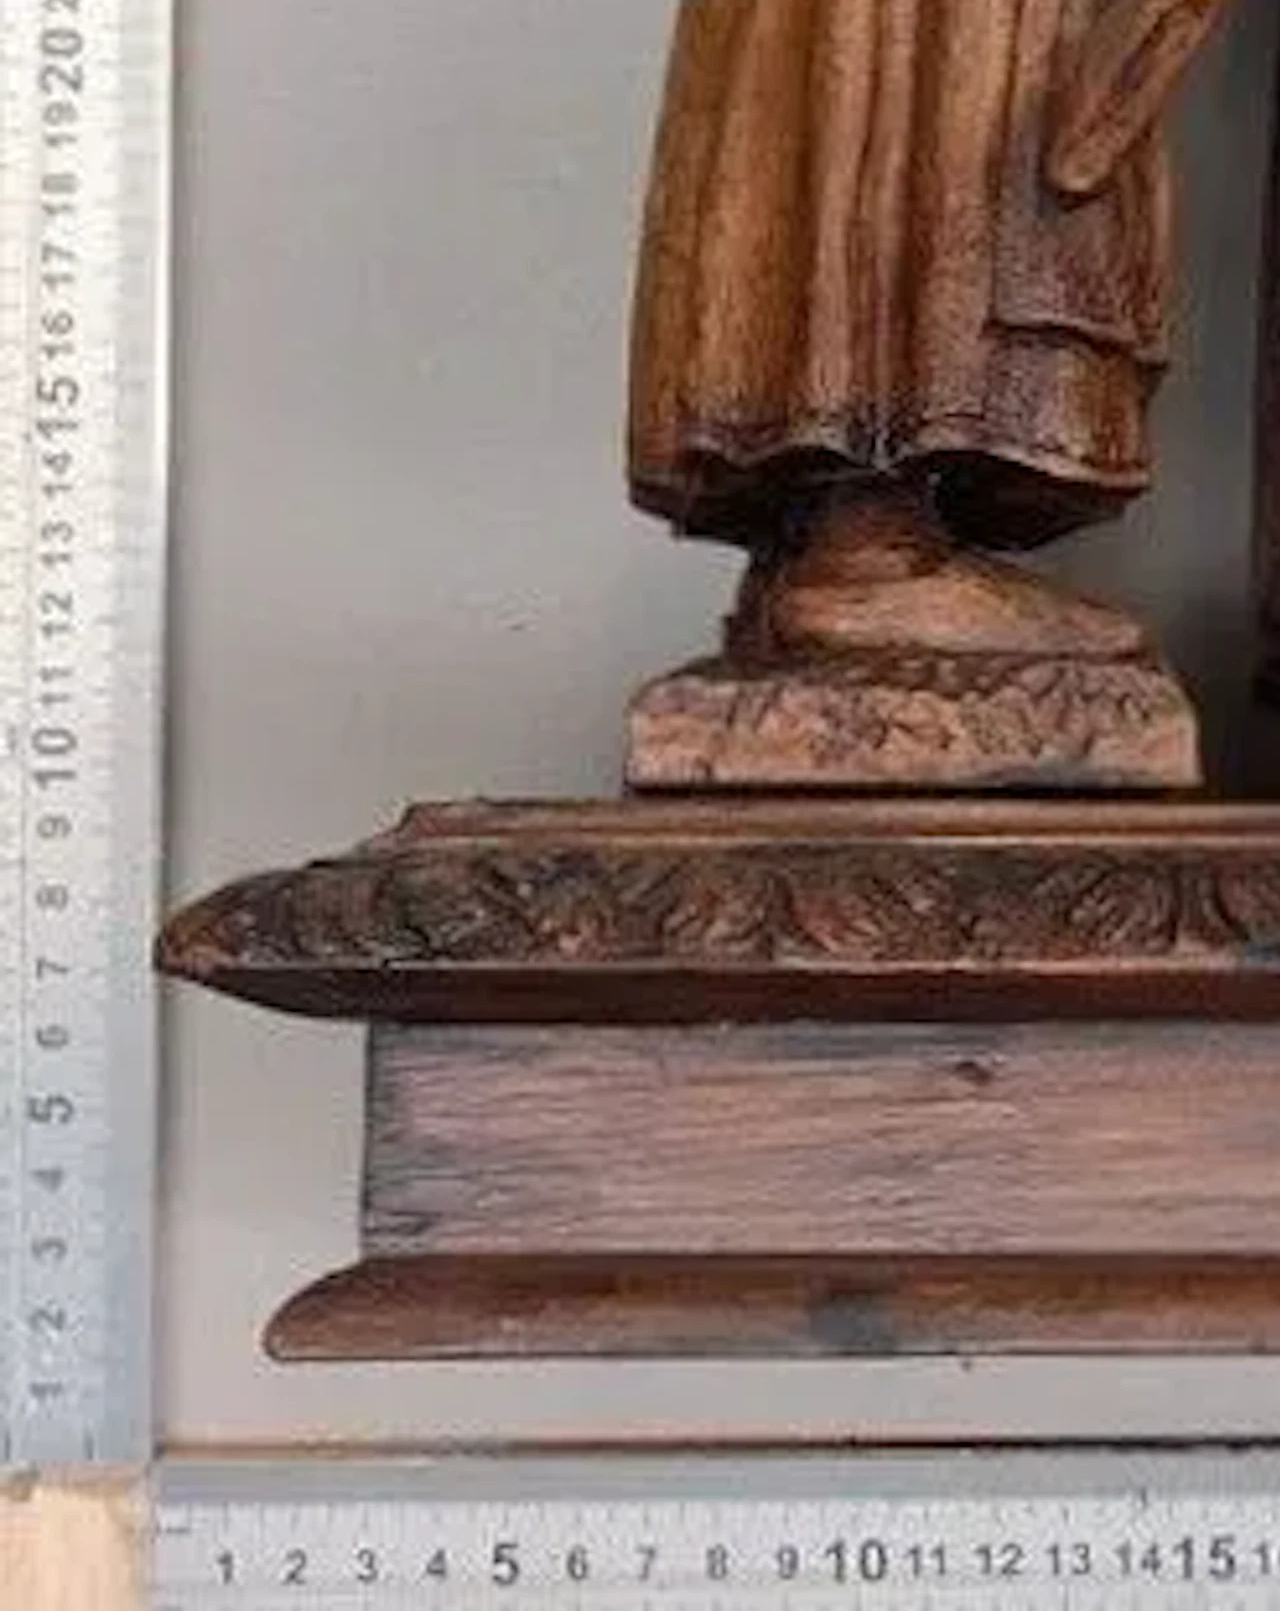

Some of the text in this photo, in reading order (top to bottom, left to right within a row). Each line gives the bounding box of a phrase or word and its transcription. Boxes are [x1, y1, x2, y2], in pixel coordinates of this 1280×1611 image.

[37, 27, 84, 94] 20
[41, 101, 77, 148] 19
[39, 172, 76, 217] 18
[40, 242, 75, 290] 17
[39, 311, 75, 359] 16
[34, 375, 80, 440] 15
[41, 451, 72, 498] 14
[39, 521, 74, 567] 13
[39, 591, 73, 638] 12
[38, 667, 71, 706] 11
[30, 727, 78, 789] 10
[36, 815, 72, 839] 9
[35, 886, 69, 909] 8
[35, 956, 69, 979] 7
[34, 1024, 69, 1049] 6
[27, 1094, 75, 1124] 5
[32, 1168, 64, 1190] 4
[31, 1238, 67, 1258] 3
[28, 1308, 66, 1330] 2
[30, 1383, 62, 1398] 1
[217, 1552, 233, 1585] 1
[283, 1549, 307, 1586] 2
[356, 1549, 378, 1585] 3
[425, 1549, 448, 1580] 4
[491, 1542, 521, 1588] 5
[566, 1548, 589, 1583] 6
[638, 1547, 657, 1582] 7
[706, 1545, 729, 1581] 8
[775, 1546, 799, 1581] 9
[825, 1539, 889, 1584] 10
[907, 1545, 947, 1578] 11
[975, 1542, 1024, 1579] 12
[1047, 1543, 1092, 1577] 13
[1116, 1543, 1162, 1575] 14
[1174, 1535, 1237, 1581] 15
